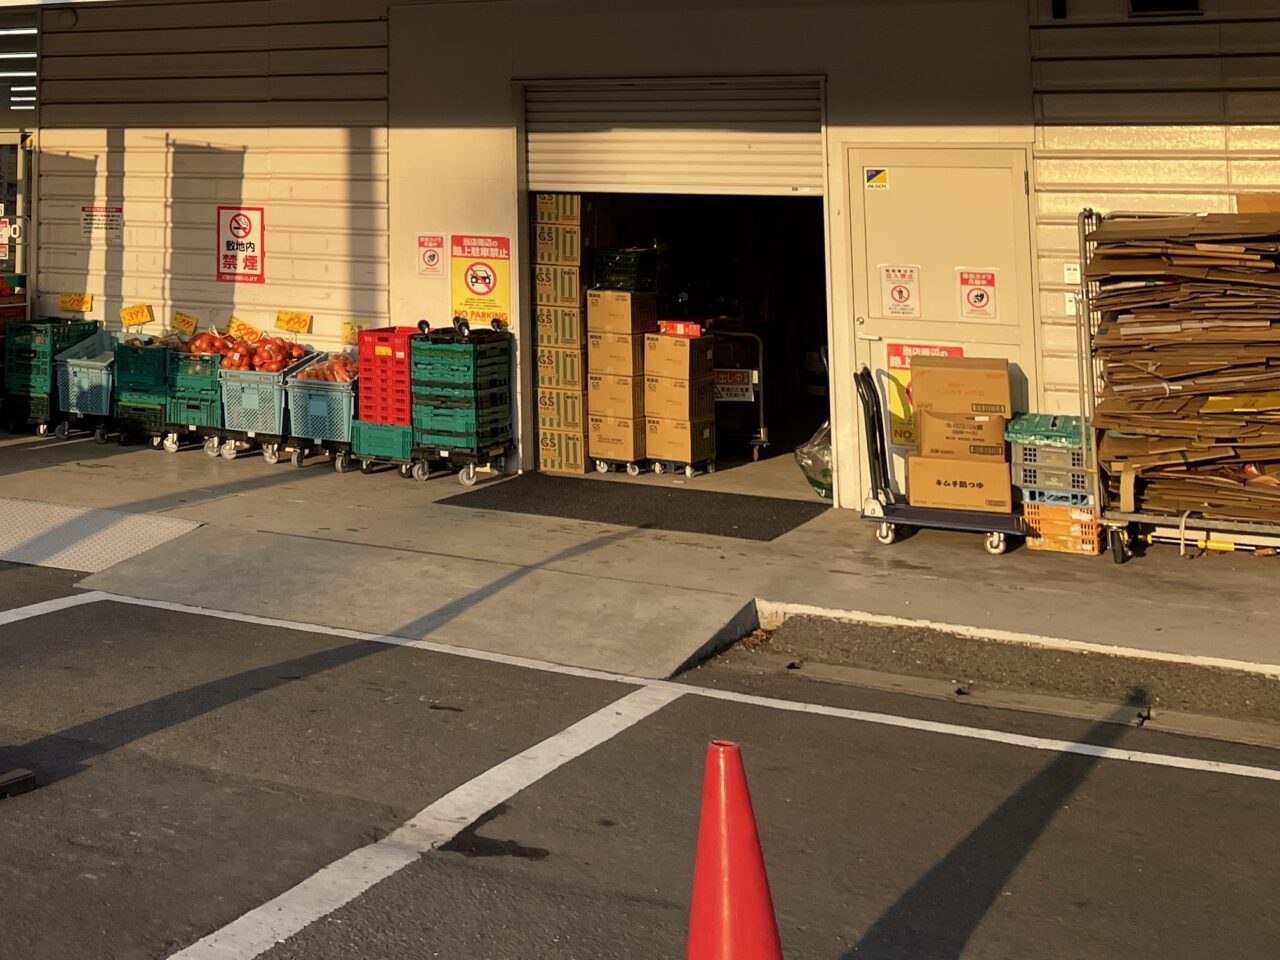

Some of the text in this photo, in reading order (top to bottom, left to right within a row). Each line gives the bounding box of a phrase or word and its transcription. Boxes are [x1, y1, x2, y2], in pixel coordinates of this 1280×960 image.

[225, 240, 256, 253] 敷地内
[470, 310, 508, 321] PARKING
[935, 479, 985, 489] キムチ鍋つゆ
